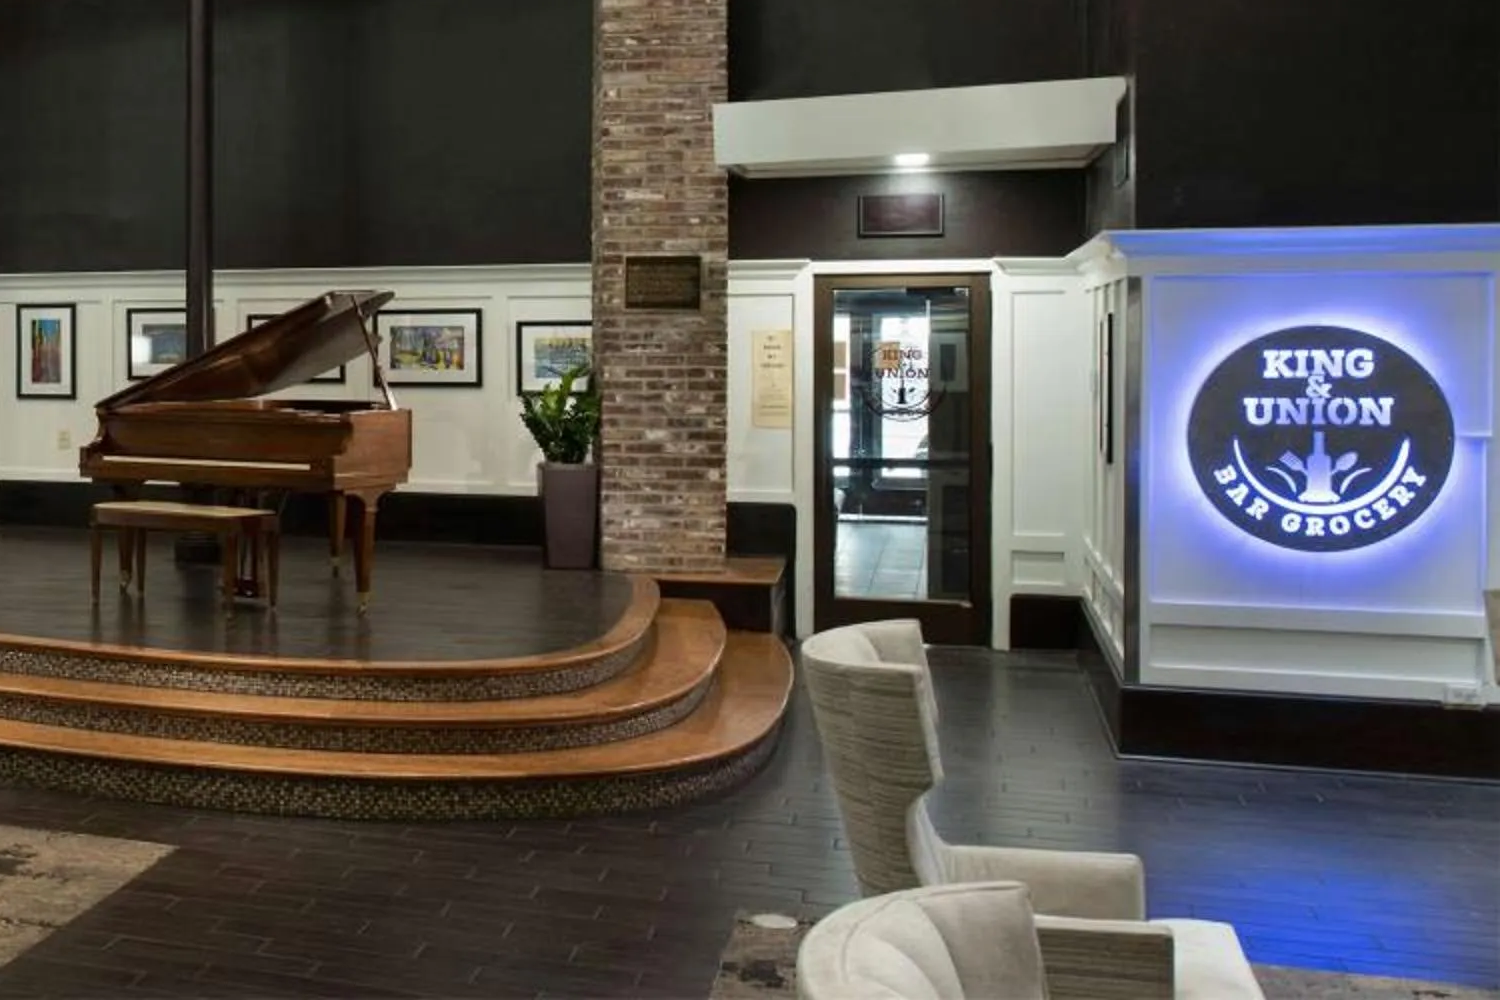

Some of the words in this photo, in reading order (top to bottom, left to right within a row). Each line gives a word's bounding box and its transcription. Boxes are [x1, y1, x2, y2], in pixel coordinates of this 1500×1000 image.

[1262, 348, 1375, 379] KING
[1305, 374, 1332, 399] &
[1243, 397, 1394, 426] UNION
[1213, 464, 1270, 521] BAR
[1280, 465, 1427, 537] GROCERY
